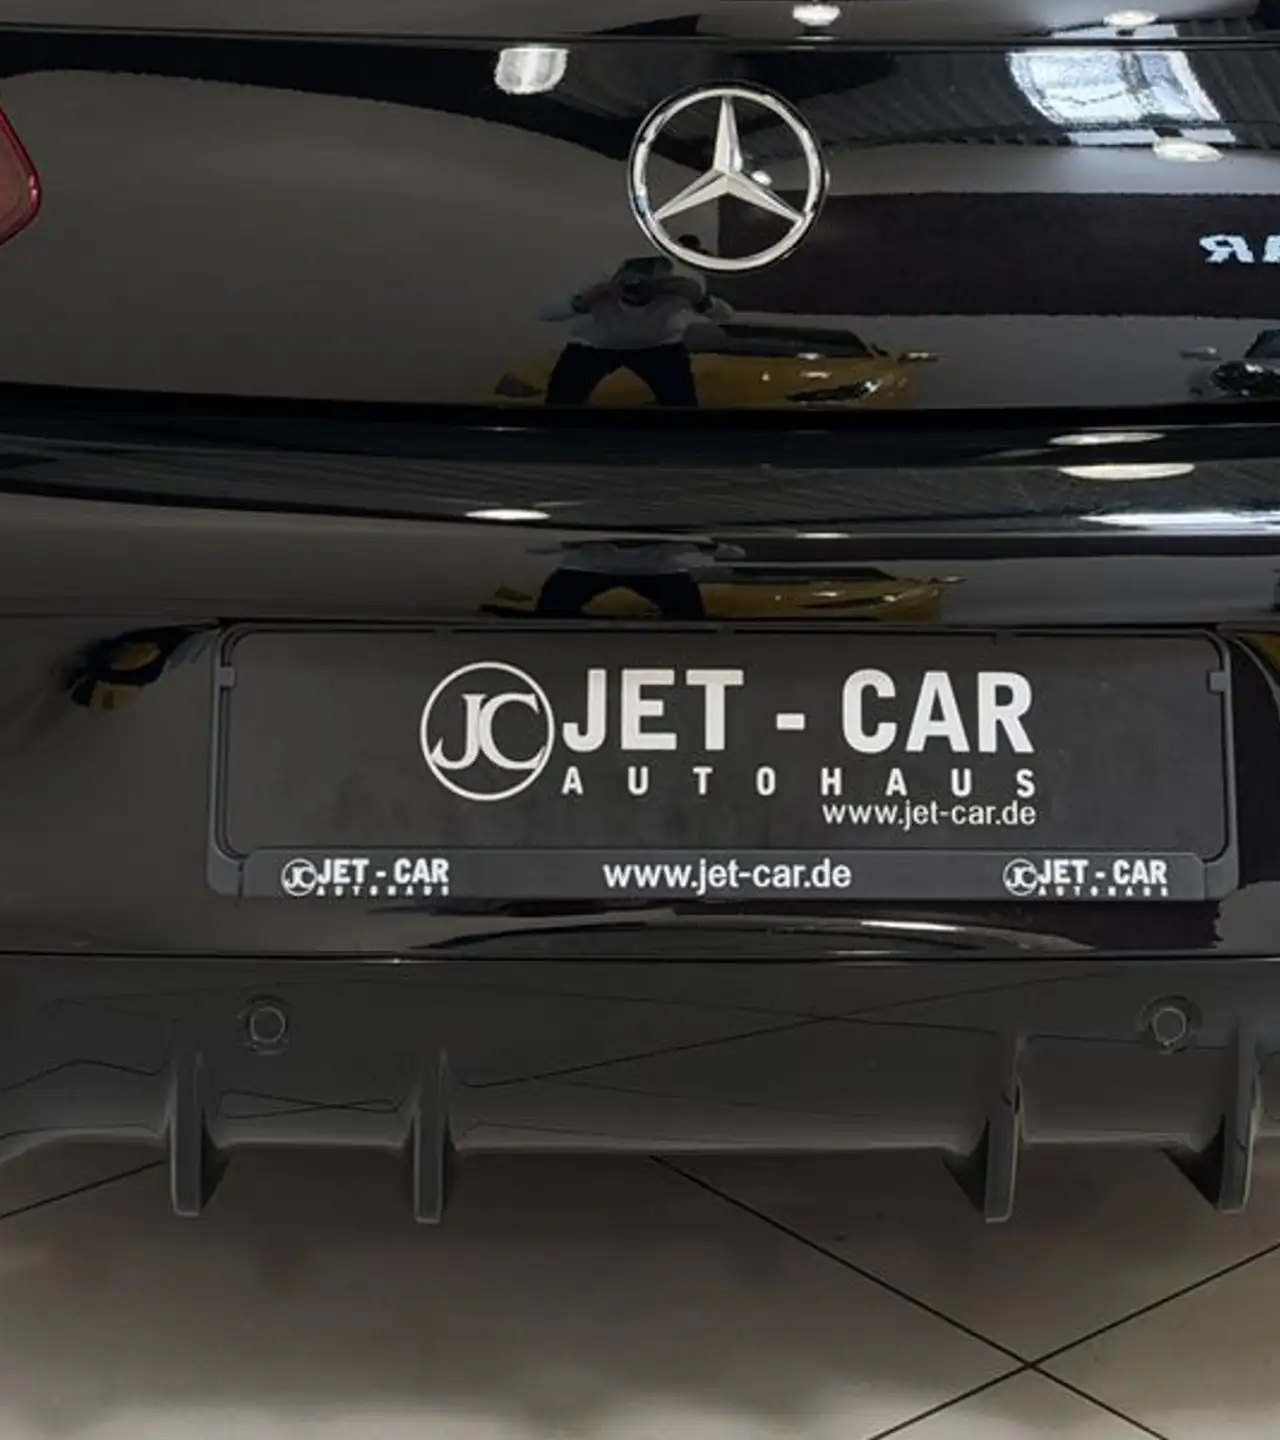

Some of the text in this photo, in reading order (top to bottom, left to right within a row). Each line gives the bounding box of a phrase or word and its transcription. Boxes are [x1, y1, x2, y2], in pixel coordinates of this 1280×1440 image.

[562, 668, 744, 754] JET
[841, 667, 1036, 754] CAR
[561, 764, 1037, 799] AUTOHAUS
[822, 794, 1037, 832] www.jet-car.de
[317, 857, 371, 885] JET
[393, 857, 451, 885] CAR
[602, 857, 854, 897] www.jet-car.de
[1038, 857, 1090, 885] JET
[1112, 857, 1169, 885] CAR
